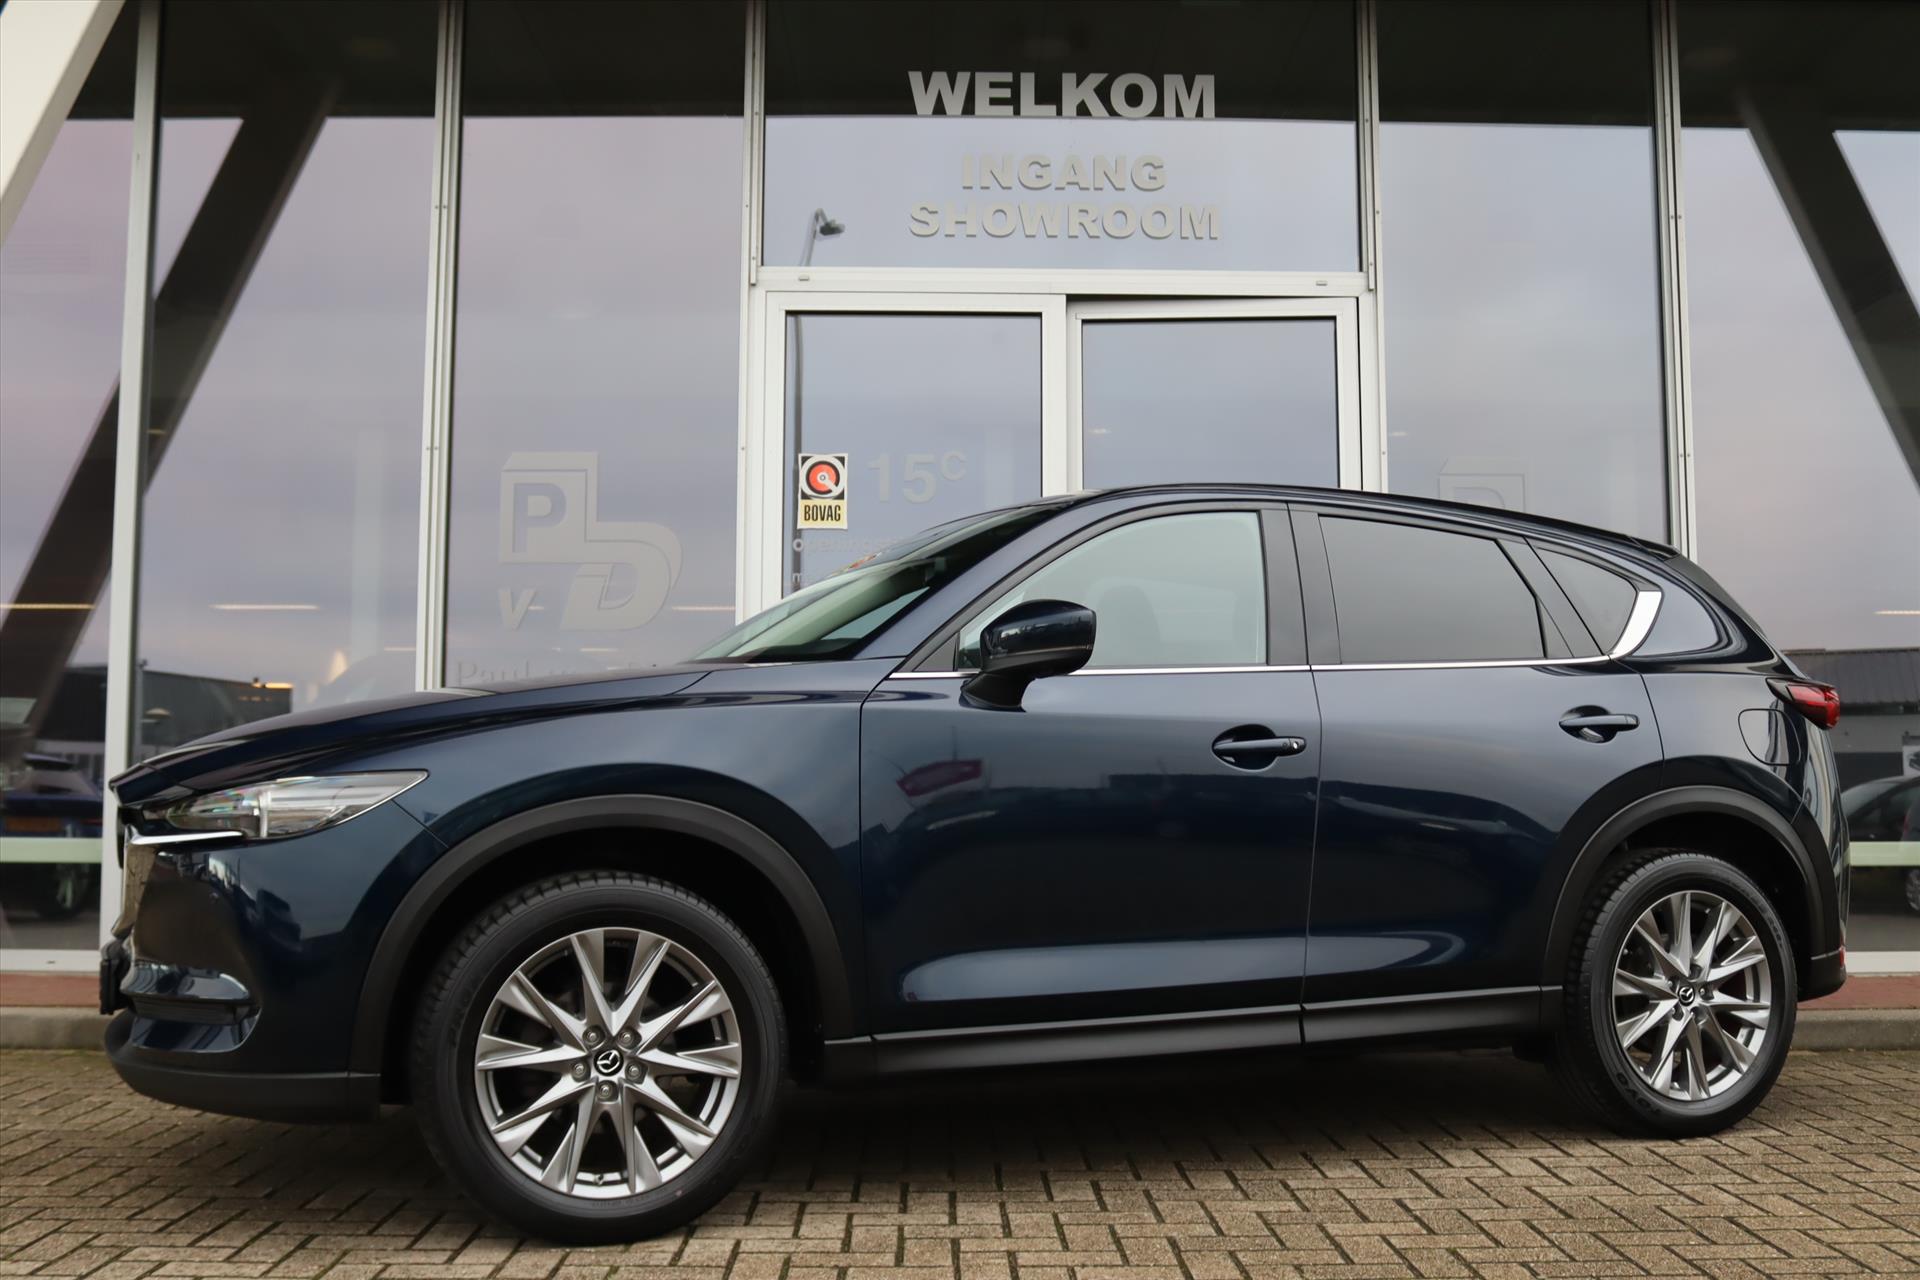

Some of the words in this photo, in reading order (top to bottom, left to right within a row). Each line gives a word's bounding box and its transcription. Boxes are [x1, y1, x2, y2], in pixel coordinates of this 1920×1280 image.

[908, 71, 1216, 120] WELKOM
[961, 153, 1168, 192] INGANG
[908, 201, 1223, 240] SHOWROOM
[803, 504, 841, 522] BOVAG
